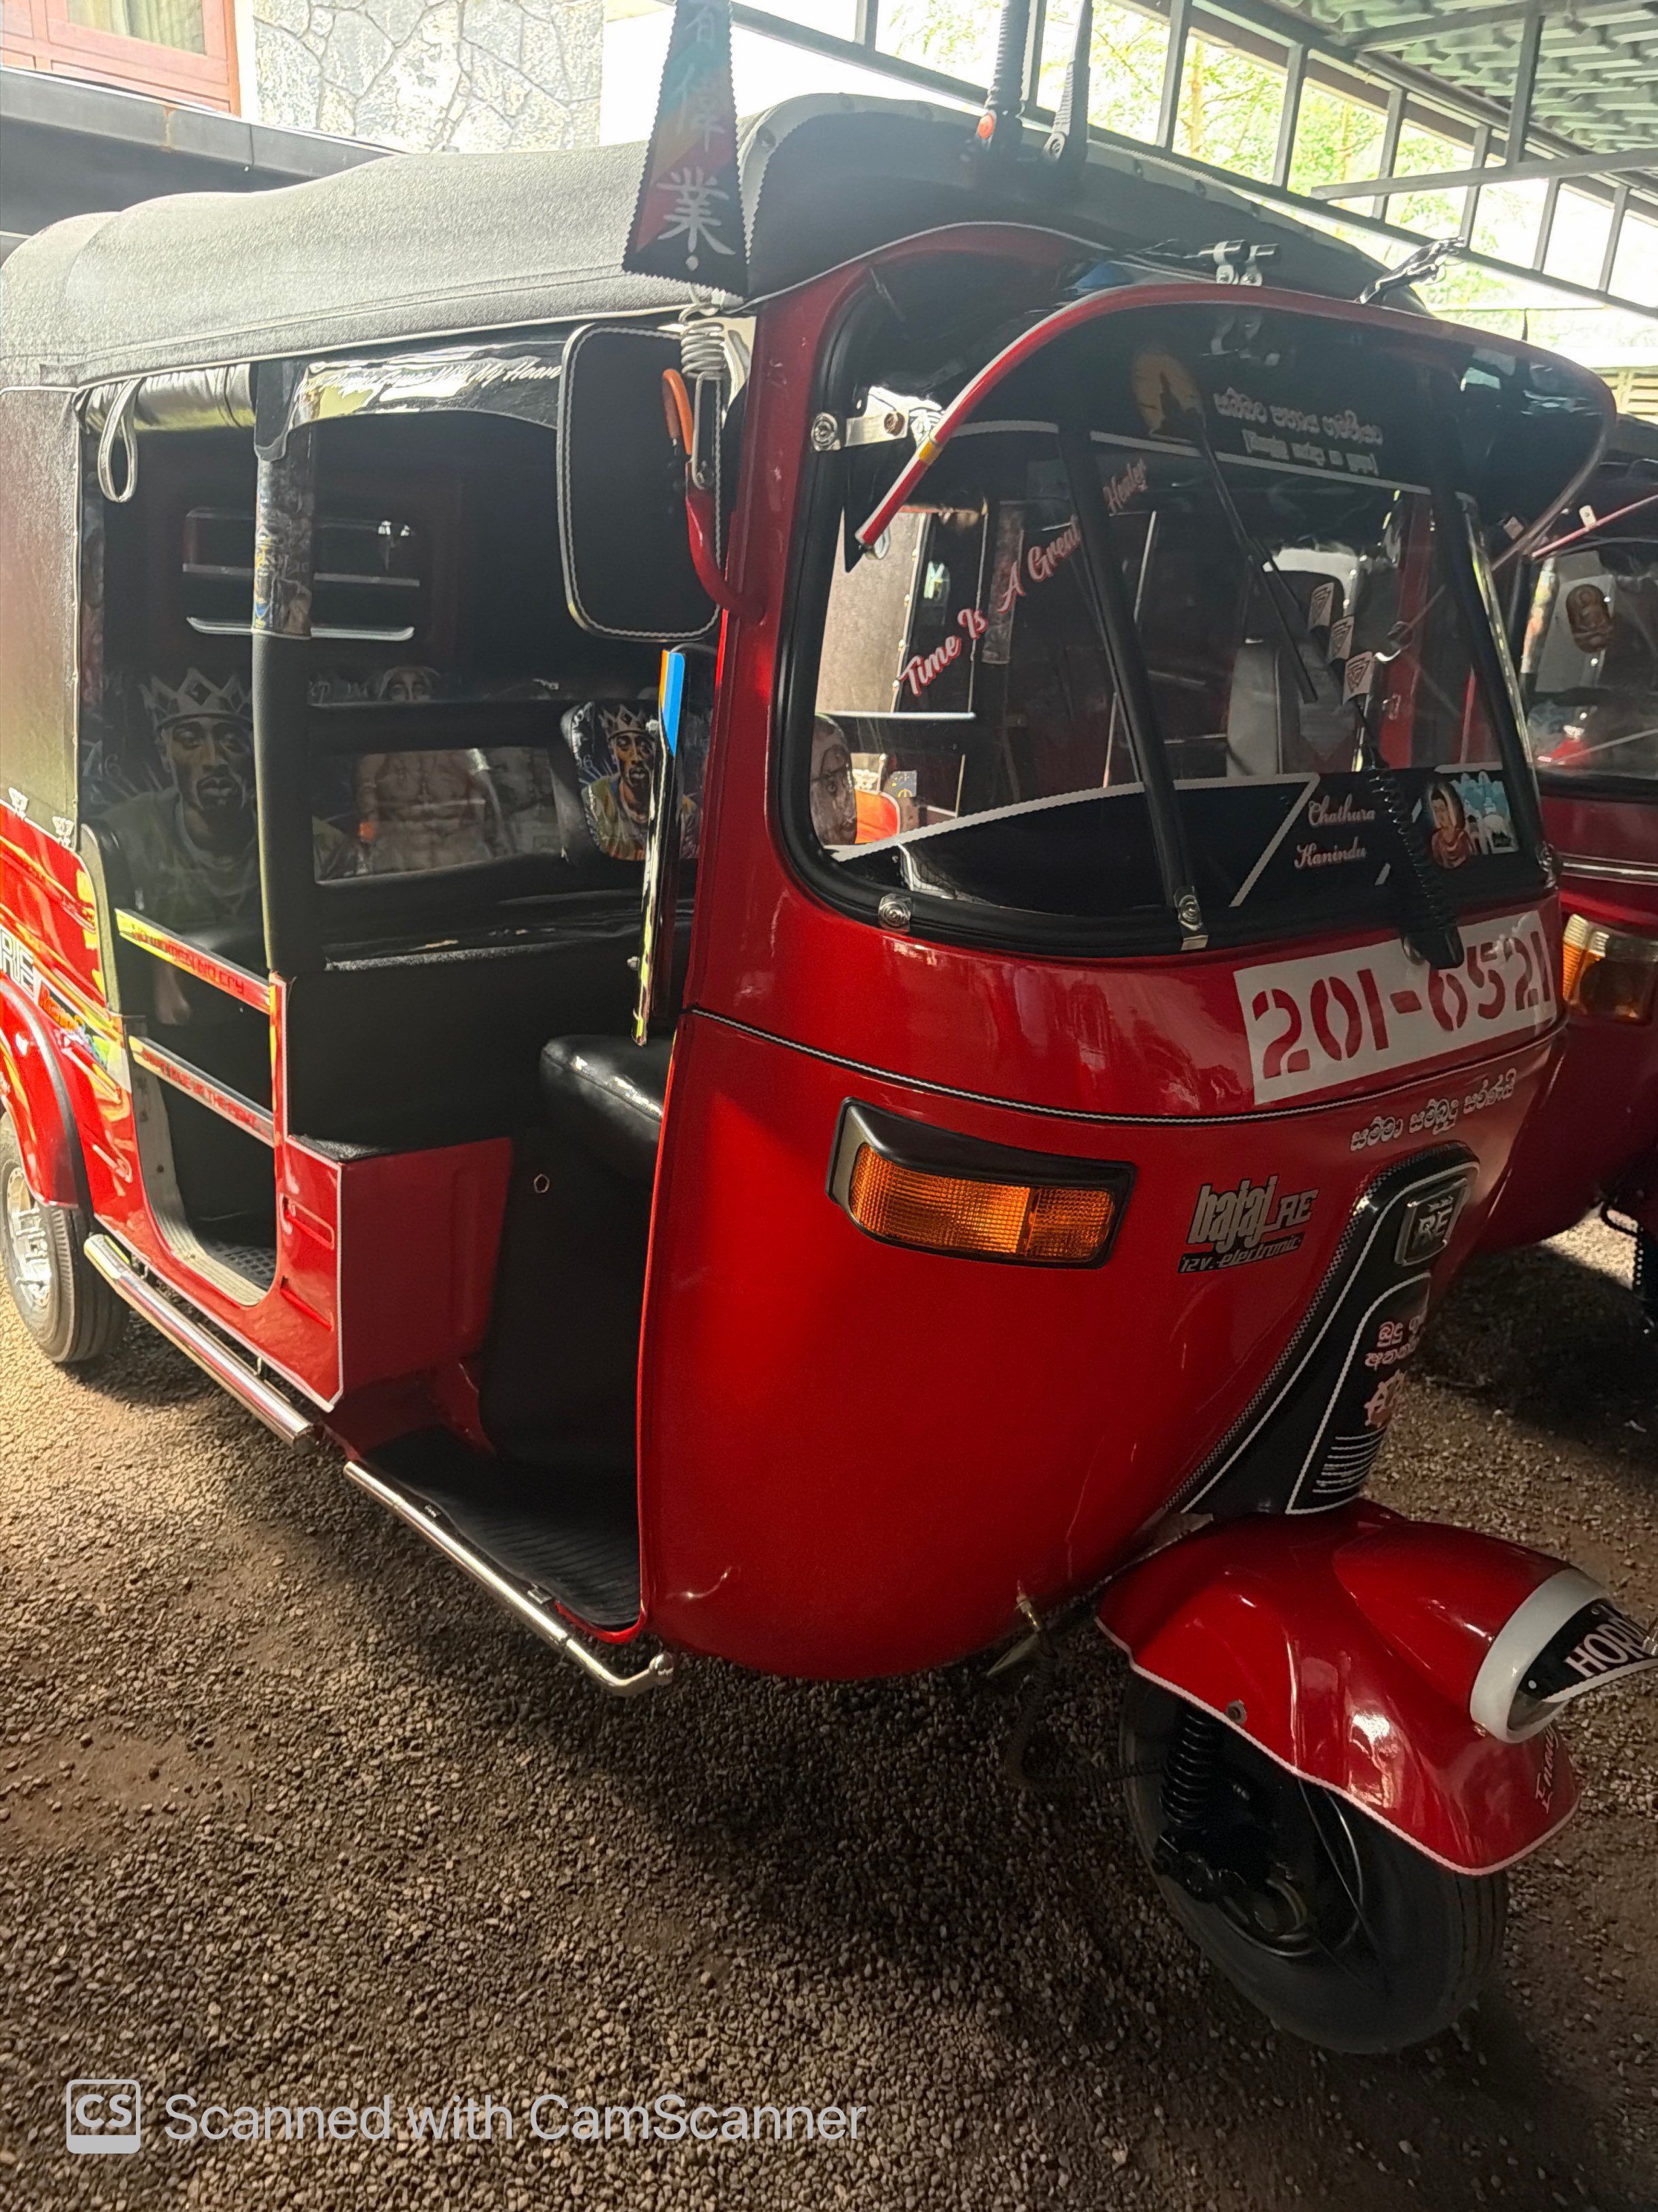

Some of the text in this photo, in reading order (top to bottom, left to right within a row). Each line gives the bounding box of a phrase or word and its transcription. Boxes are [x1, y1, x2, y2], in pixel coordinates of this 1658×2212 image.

[897, 635, 962, 697] Time
[957, 608, 989, 640] Is
[997, 560, 1026, 614] A
[1308, 793, 1376, 827] Chathura
[1252, 931, 1551, 1080] 201-6521
[1187, 1175, 1320, 1254] bajaj RE
